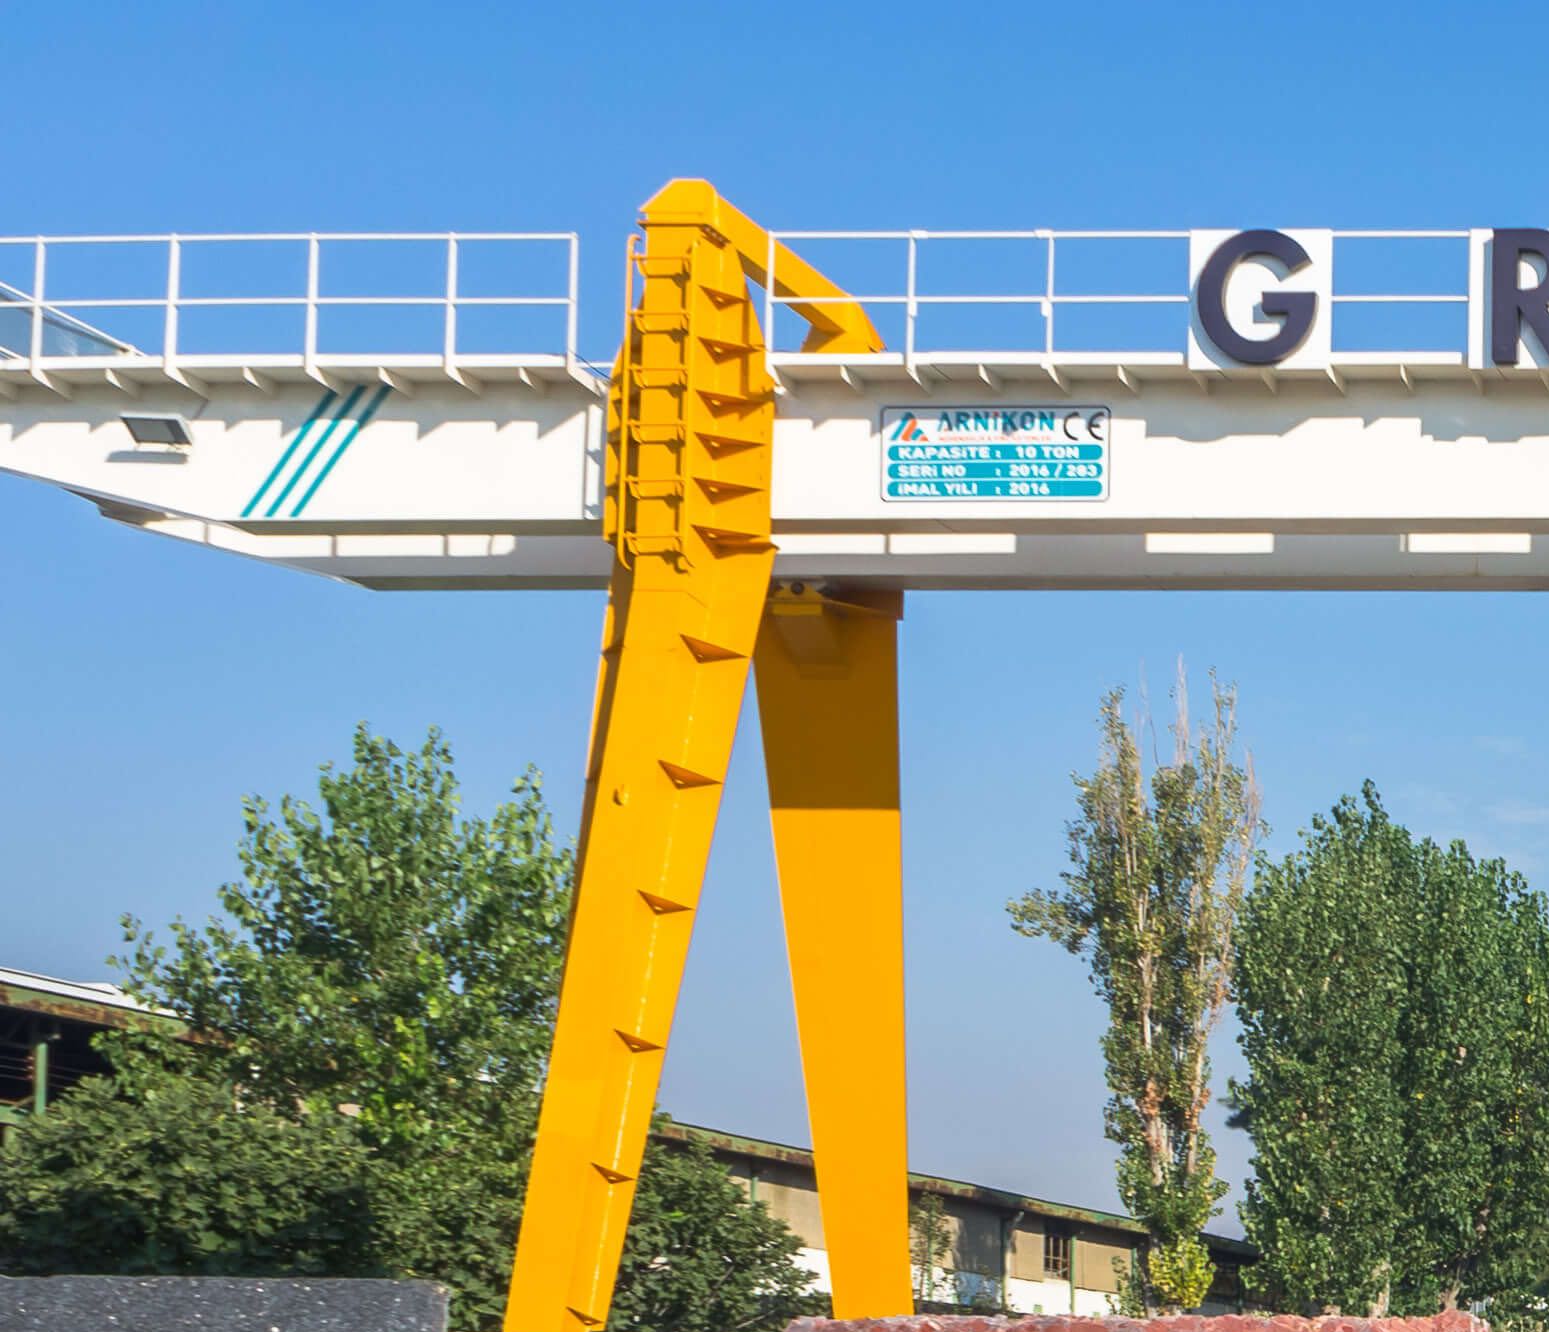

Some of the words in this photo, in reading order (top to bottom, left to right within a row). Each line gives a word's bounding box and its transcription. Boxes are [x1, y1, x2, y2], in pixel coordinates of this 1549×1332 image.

[1015, 446, 1037, 458] 10
[1040, 446, 1079, 459] TON
[941, 464, 966, 476] NO
